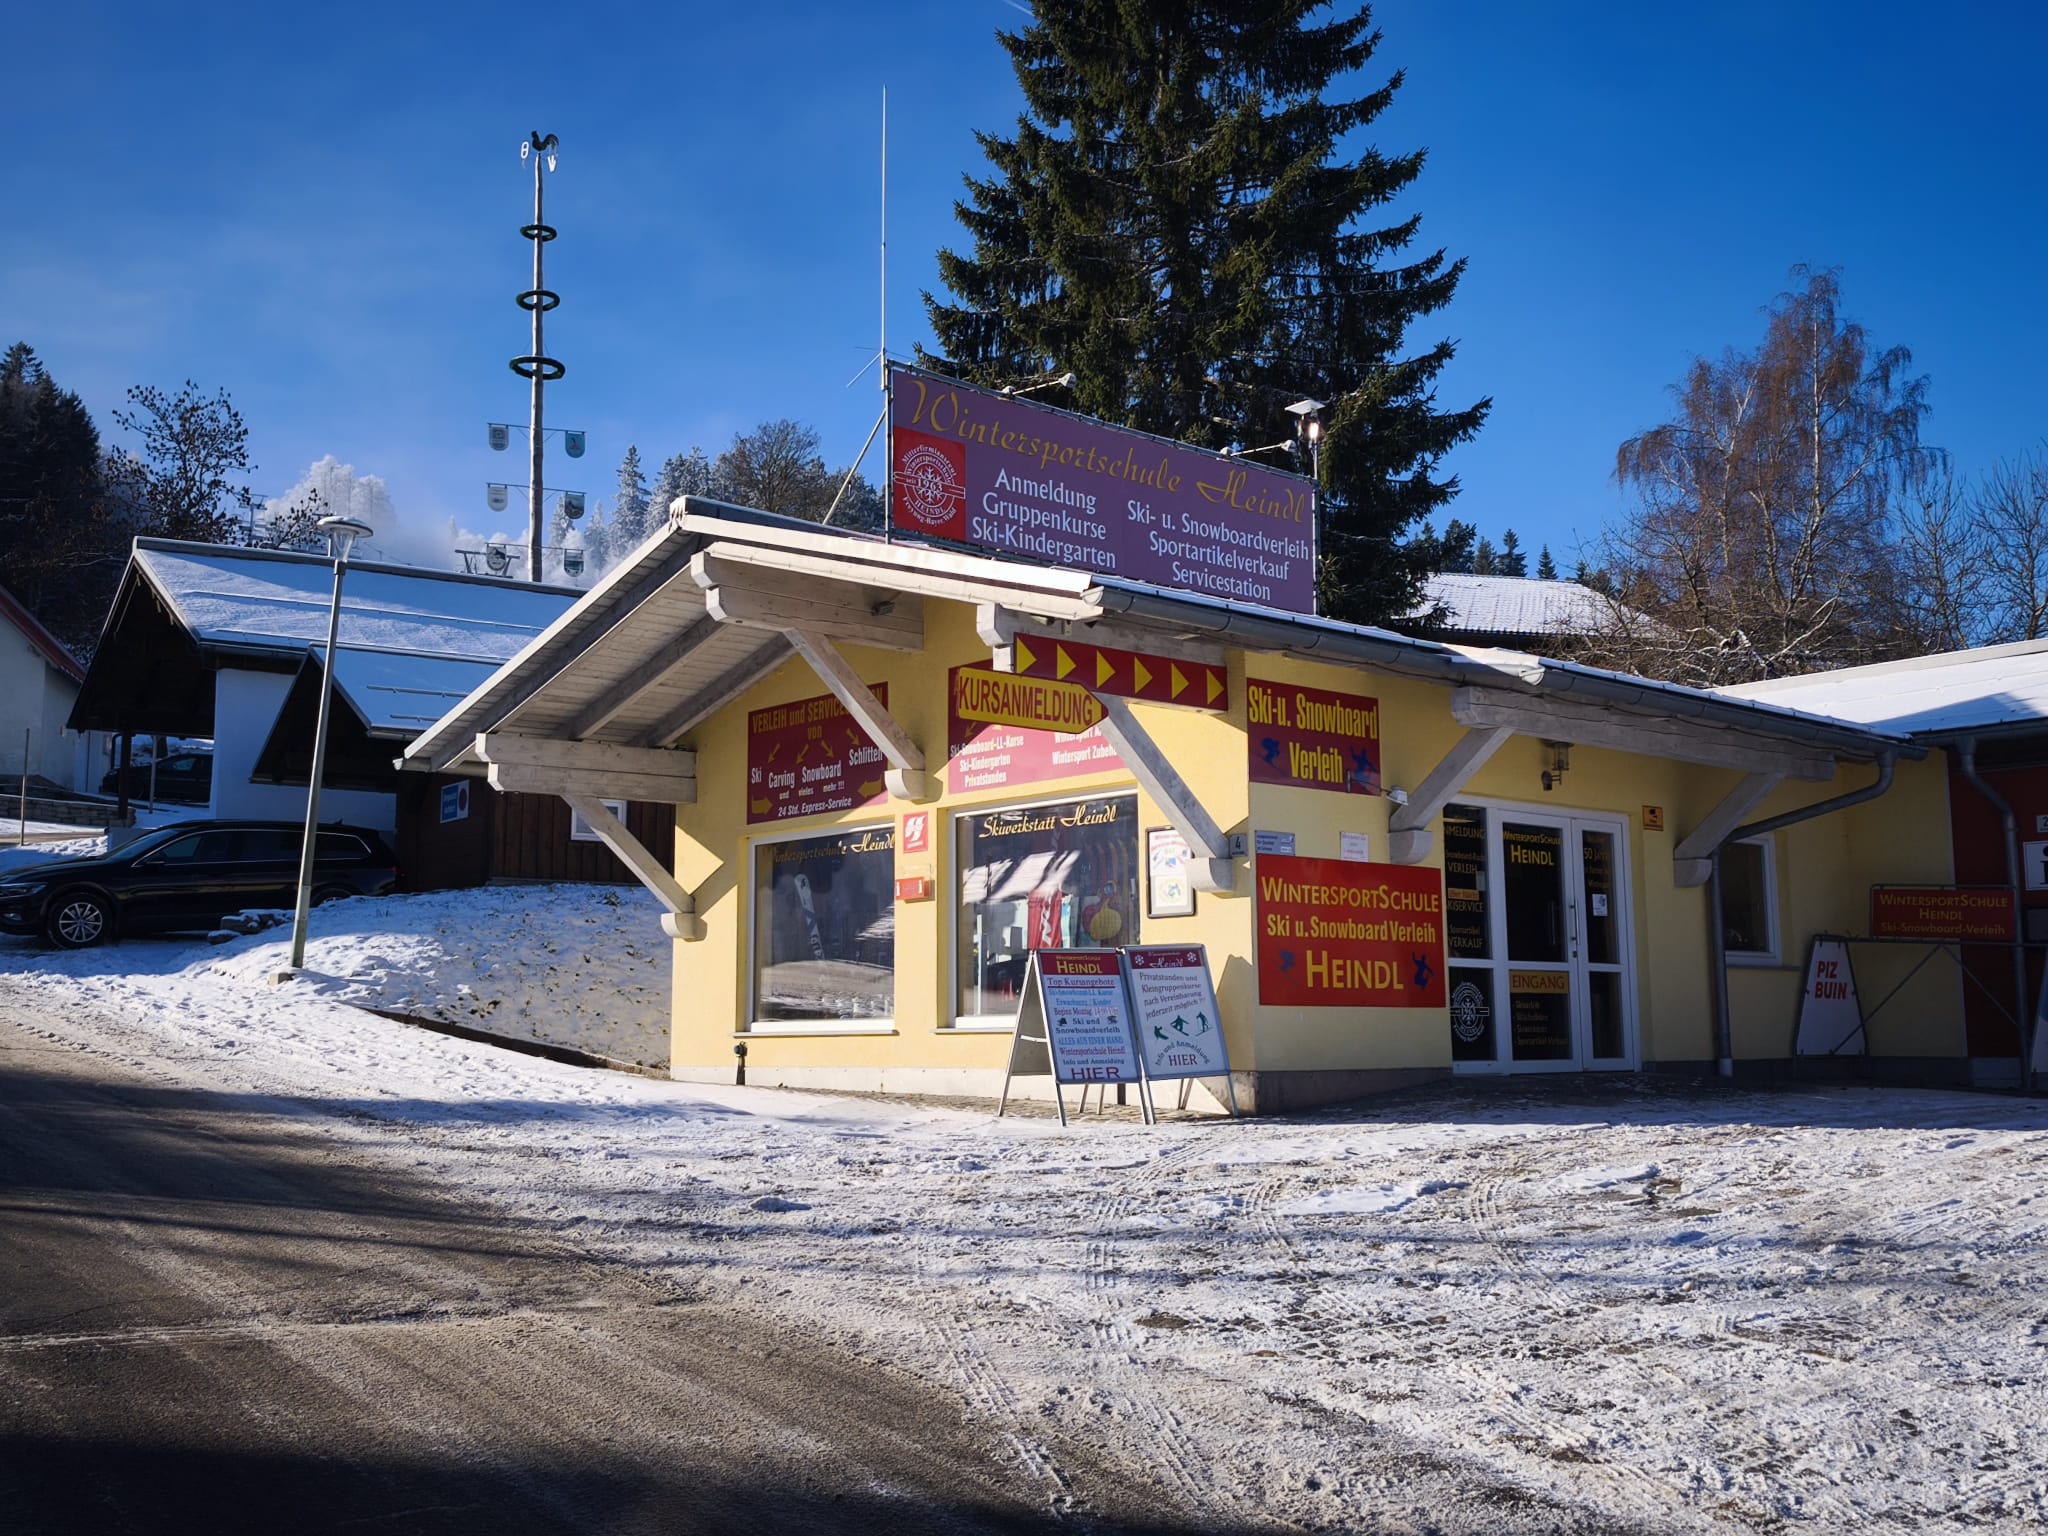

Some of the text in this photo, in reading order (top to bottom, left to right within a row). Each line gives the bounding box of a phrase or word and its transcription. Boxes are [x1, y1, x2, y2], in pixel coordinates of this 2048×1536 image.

[907, 380, 1305, 523] Wintersportschule Heindl
[918, 478, 943, 492] 1963
[994, 468, 1096, 515] Anmeldung
[983, 494, 1107, 540] Gruppenkurse
[1128, 500, 1310, 561] Ski- u. Snowboardverleih
[972, 517, 1116, 569] Ski-Kindergarten
[1149, 530, 1290, 580] Sportartikelverkauf
[1172, 561, 1271, 601] Servicestation
[959, 675, 1093, 726] KURSANMELDUNG
[752, 708, 787, 734] VERLEIH
[789, 705, 805, 726] und
[1296, 692, 1378, 739] Snowboard
[808, 725, 822, 740] von
[959, 754, 1011, 772] Ski-Kindergarten
[1052, 746, 1091, 765] Wintersport
[1289, 741, 1343, 784] Verleih
[751, 747, 883, 788] Ski Carving Snowboard Schlitten
[823, 782, 836, 792] mehr
[964, 770, 1007, 788] Privatstunden
[778, 797, 852, 817] 24 Std. Express-Service
[978, 804, 1117, 838] Skiwerkstatt Heindl
[851, 831, 895, 852] Heindl
[1511, 845, 1555, 866] HEINDL
[1447, 862, 1478, 874] VERLEIH
[1919, 909, 1964, 921] HEINDL
[1267, 913, 1290, 937] Ski
[1310, 916, 1388, 942] Snowboard
[1389, 920, 1436, 943] Verleih
[1881, 922, 2005, 936] Ski-Snowboard-Verleih
[1448, 937, 1484, 950] VERKAUF
[1056, 960, 1103, 974] HEINDL
[1306, 950, 1404, 990] HEINDL
[1817, 961, 1838, 979] PIZ
[1512, 974, 1565, 991] EINGANG
[1814, 982, 1847, 1000] BUIN
[1055, 1026, 1120, 1034] Snowboardverleih
[1168, 1054, 1198, 1066] HIER
[1071, 1066, 1121, 1080] HIER
